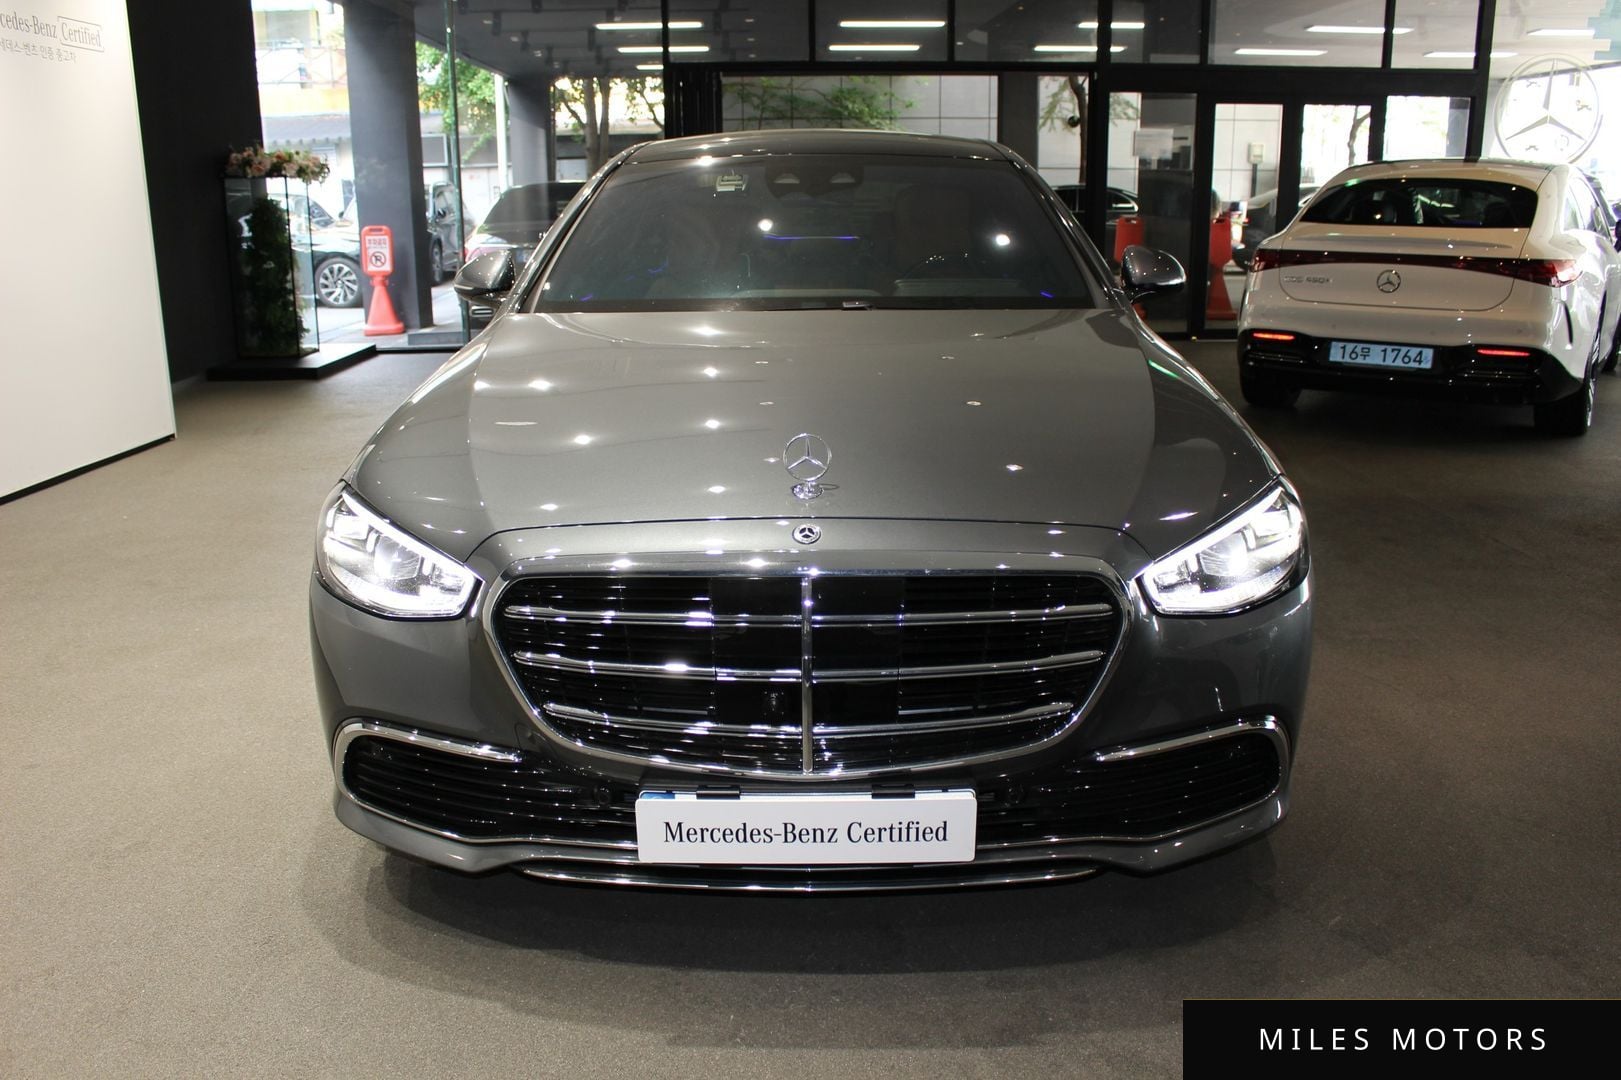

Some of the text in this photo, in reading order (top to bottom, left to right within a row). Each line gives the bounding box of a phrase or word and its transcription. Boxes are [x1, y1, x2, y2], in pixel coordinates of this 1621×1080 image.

[61, 22, 102, 48] Certified
[56, 48, 77, 63] 중고차
[1340, 344, 1424, 366] 16무 1764
[663, 820, 949, 844] Mercedes-Benz Certified
